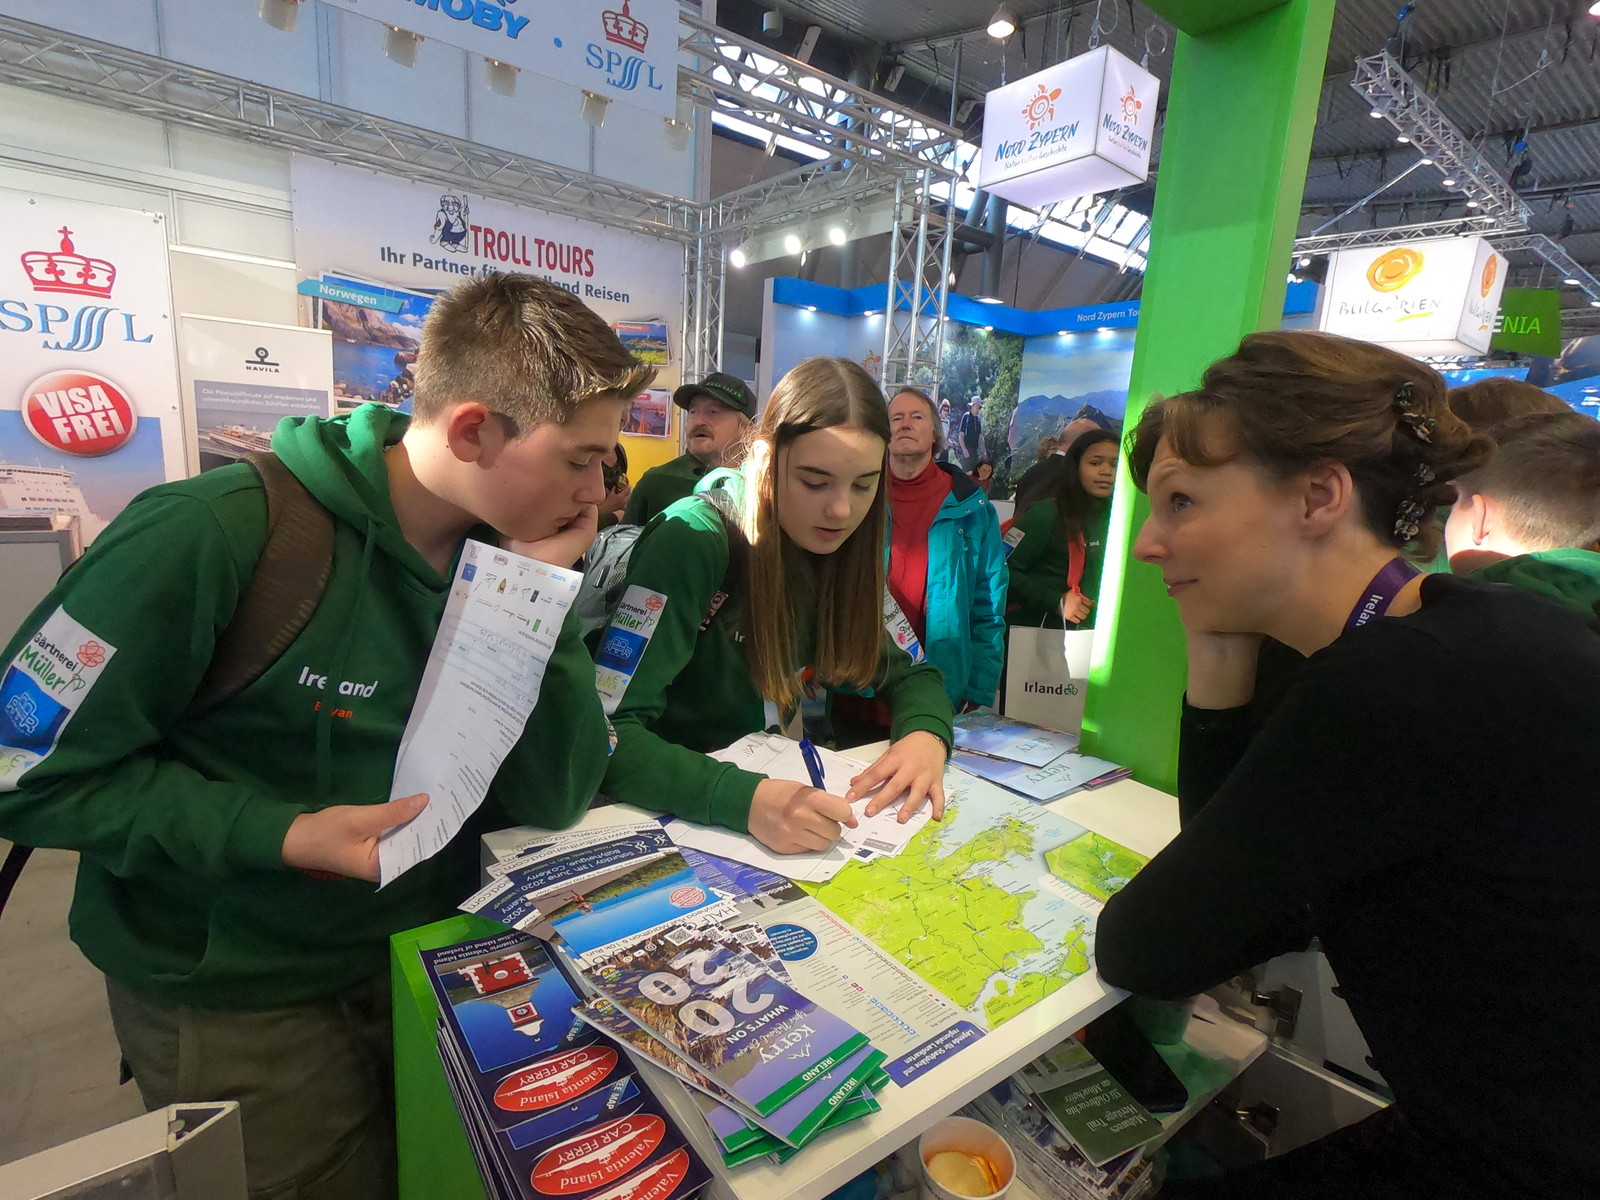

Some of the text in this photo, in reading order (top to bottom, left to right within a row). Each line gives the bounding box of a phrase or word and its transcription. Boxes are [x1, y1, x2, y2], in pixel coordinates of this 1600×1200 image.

[995, 139, 1026, 162] NORD
[1028, 121, 1079, 151] ZYPERN
[470, 224, 595, 278] TROLL TOURS
[380, 246, 406, 267] Ihr
[412, 252, 477, 277] Partner
[585, 284, 630, 304] Reisen
[318, 284, 378, 306] Norwegen
[1077, 312, 1097, 322] Nord
[1097, 309, 1126, 322] Zypern
[245, 365, 281, 374] HAVILA
[34, 384, 115, 419] VISA
[51, 410, 126, 444] FREI
[1355, 594, 1384, 627] Irelan
[34, 632, 79, 673] Gärtnerei
[18, 645, 66, 690] Müller
[298, 666, 379, 698] Ireand
[1024, 681, 1063, 696] Irland
[1026, 763, 1071, 785] Kerry
[573, 862, 592, 872] 13th
[595, 849, 634, 866] Saturday
[520, 878, 546, 891] 2020
[546, 868, 572, 881] June
[499, 905, 527, 925] 2020
[473, 938, 496, 949] Island
[627, 922, 670, 943] Marathon
[436, 946, 464, 957] Ireland
[458, 947, 488, 959] Valentia
[488, 938, 518, 951] Historic
[585, 947, 603, 958] Run
[433, 954, 457, 964] Island
[726, 1005, 789, 1044] WHAT'S ON
[758, 1023, 817, 1065] Kerry
[953, 1029, 976, 1046] Legende
[903, 1042, 937, 1065] Landkarten
[914, 1047, 946, 1069] Stadtpläne
[518, 1052, 589, 1086] CAR FERRY
[802, 1056, 834, 1082] IRELAND
[902, 1065, 916, 1078] und
[519, 1064, 608, 1107] Valentia Island
[828, 1077, 858, 1106] IRELAND
[605, 1089, 619, 1111] MAP
[1087, 1103, 1138, 1133] Heritage Trail
[1110, 1112, 1147, 1134] Maharees
[557, 1121, 633, 1164] CAR FERRY
[560, 1136, 655, 1190] Valentia Island
[636, 1169, 679, 1200] Valen
